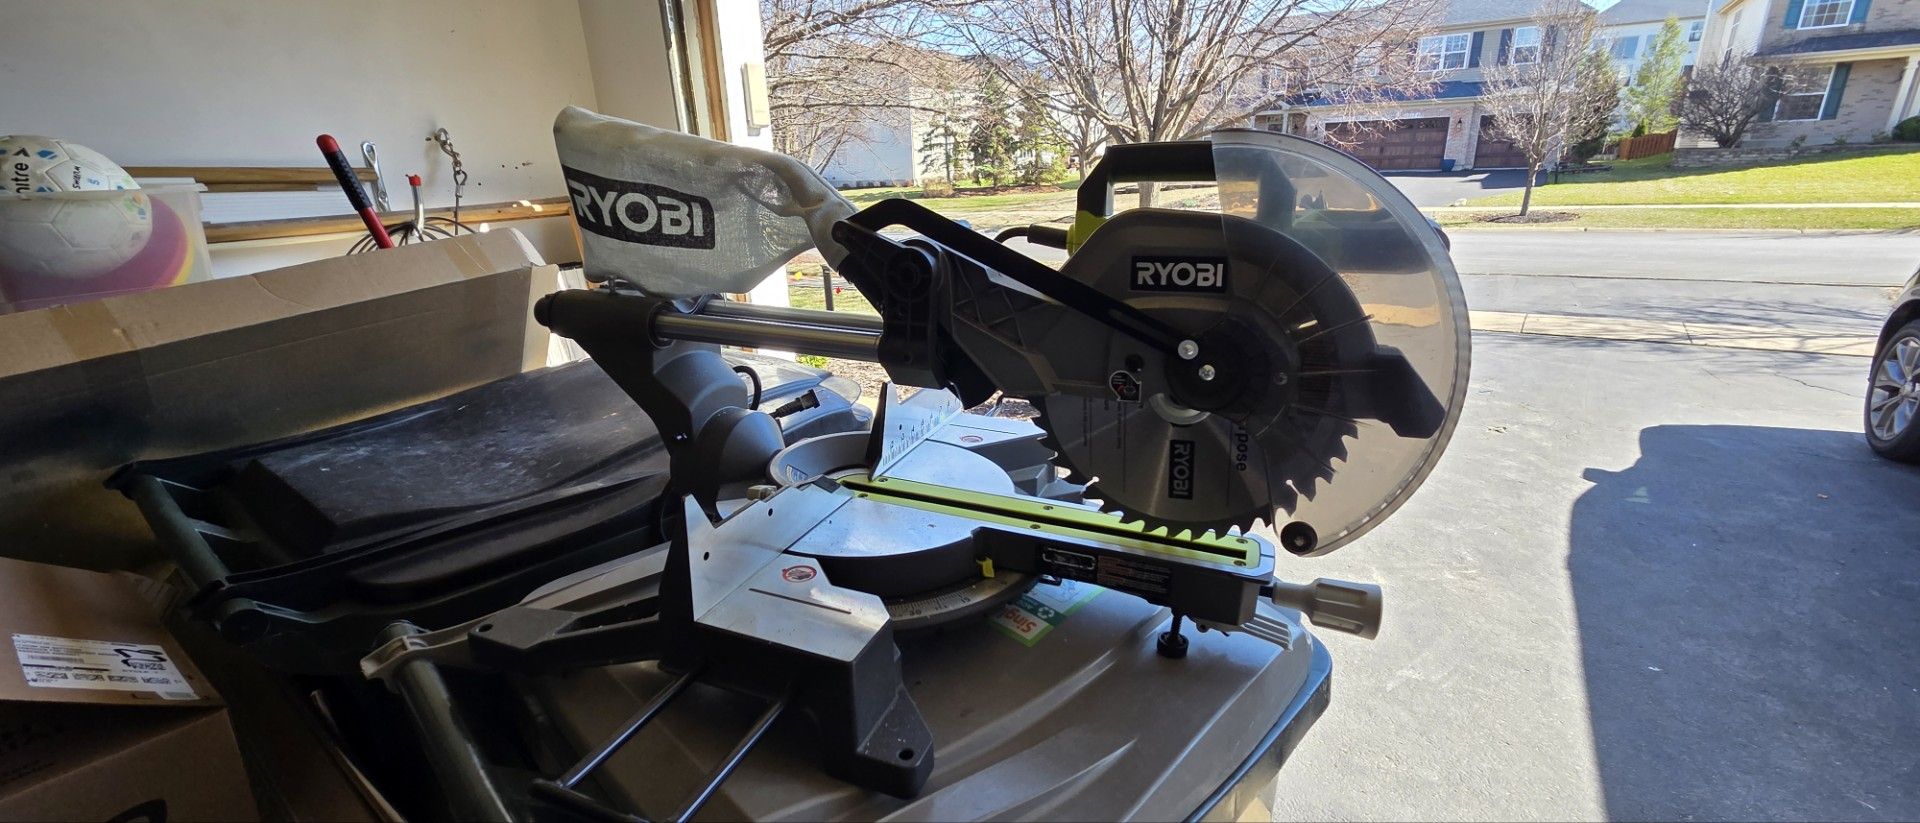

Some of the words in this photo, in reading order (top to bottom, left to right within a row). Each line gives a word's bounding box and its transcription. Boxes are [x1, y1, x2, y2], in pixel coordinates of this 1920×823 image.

[567, 178, 705, 237] RYOBI
[1136, 262, 1224, 287] RYOBI
[1173, 443, 1191, 496] RYOBI
[1003, 607, 1038, 633] Sing
